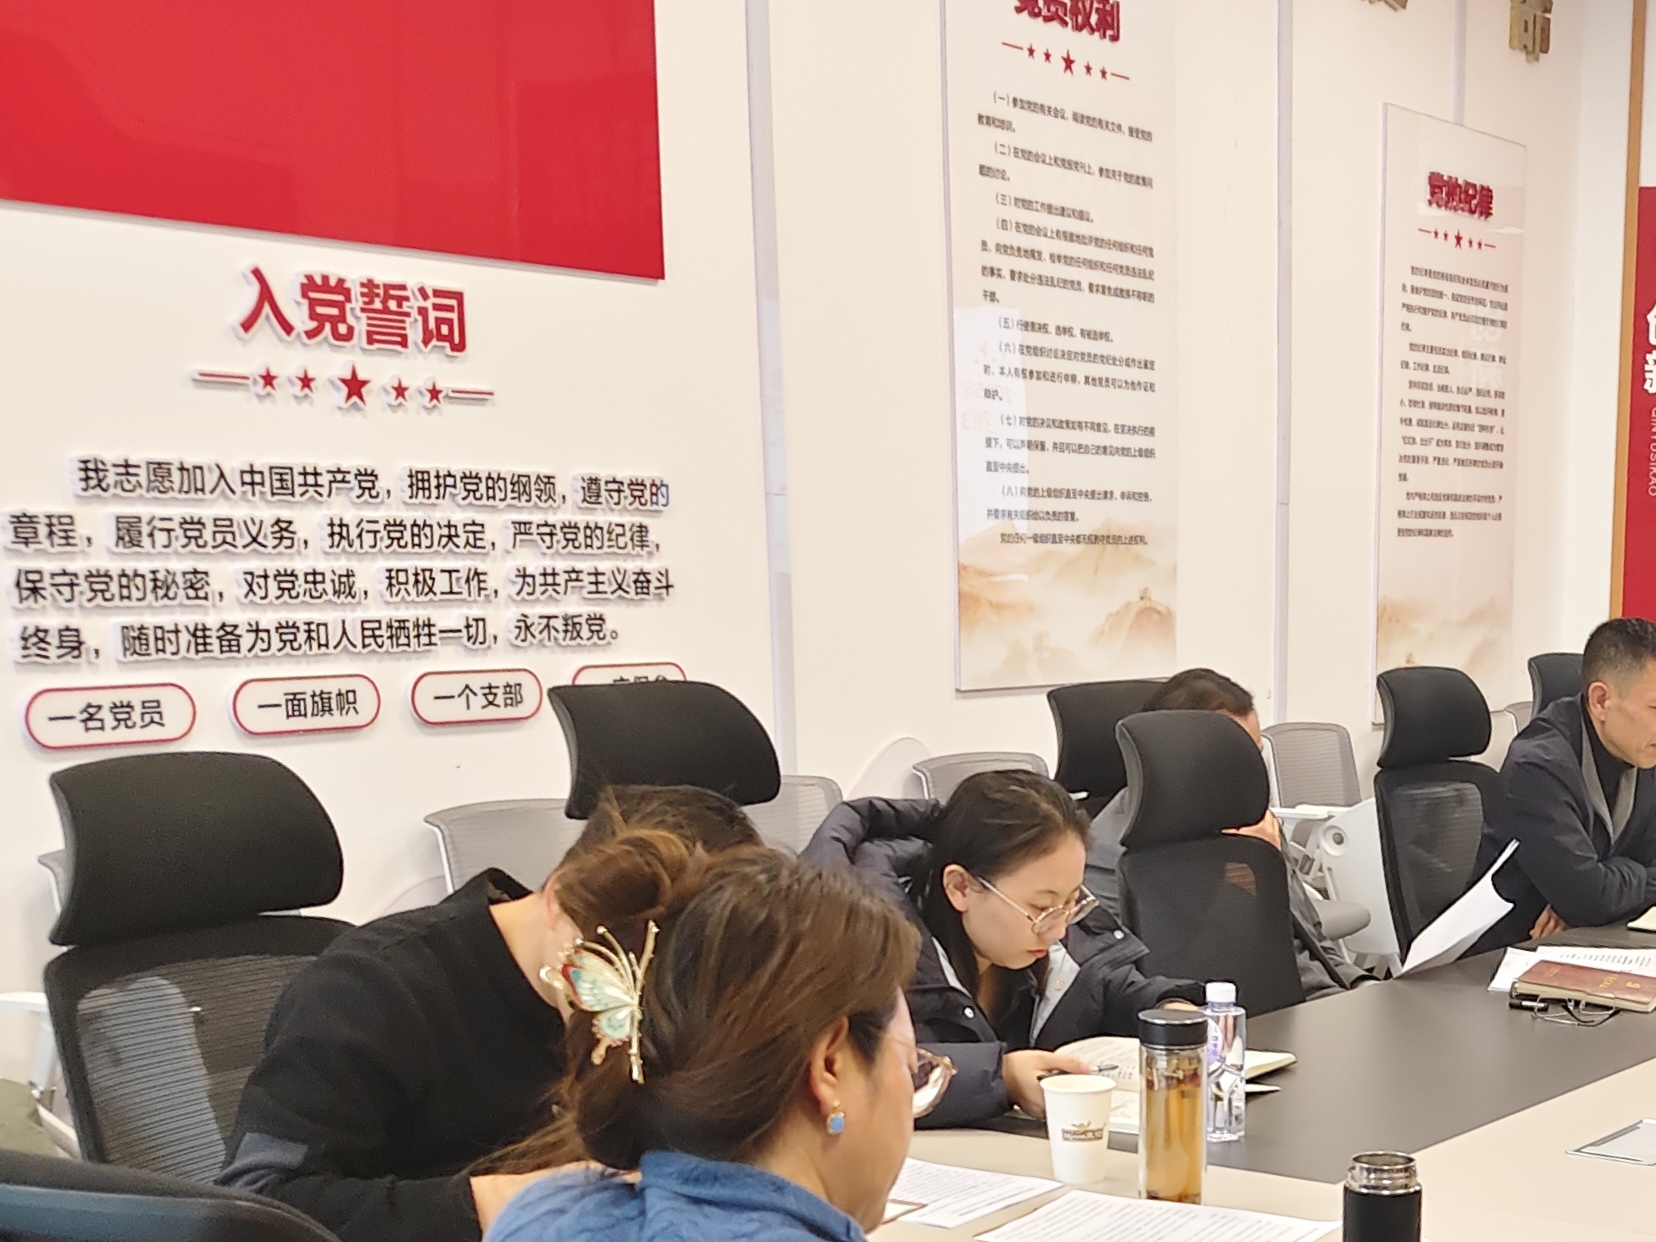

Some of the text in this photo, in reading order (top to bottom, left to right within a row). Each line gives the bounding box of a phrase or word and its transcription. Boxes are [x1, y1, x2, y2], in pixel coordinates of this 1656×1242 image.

[239, 267, 467, 353] 入党誓词
[77, 459, 670, 506] 我志愿加入中国共产党,拥护党的纲领,遵守党的
[9, 511, 662, 552] 章程,履行党员义务,执行党的决定,严守党的纪律,
[14, 566, 675, 603] 保守党的秘密,对党忠诚,积极工作,为共产主义奋斗
[19, 612, 621, 661] 终身,随时准备为党和人民牺牲一切,永不叛党。
[257, 688, 359, 720] 一面旗帜
[433, 681, 523, 711] 一个支部
[48, 699, 165, 733] 一名党员
